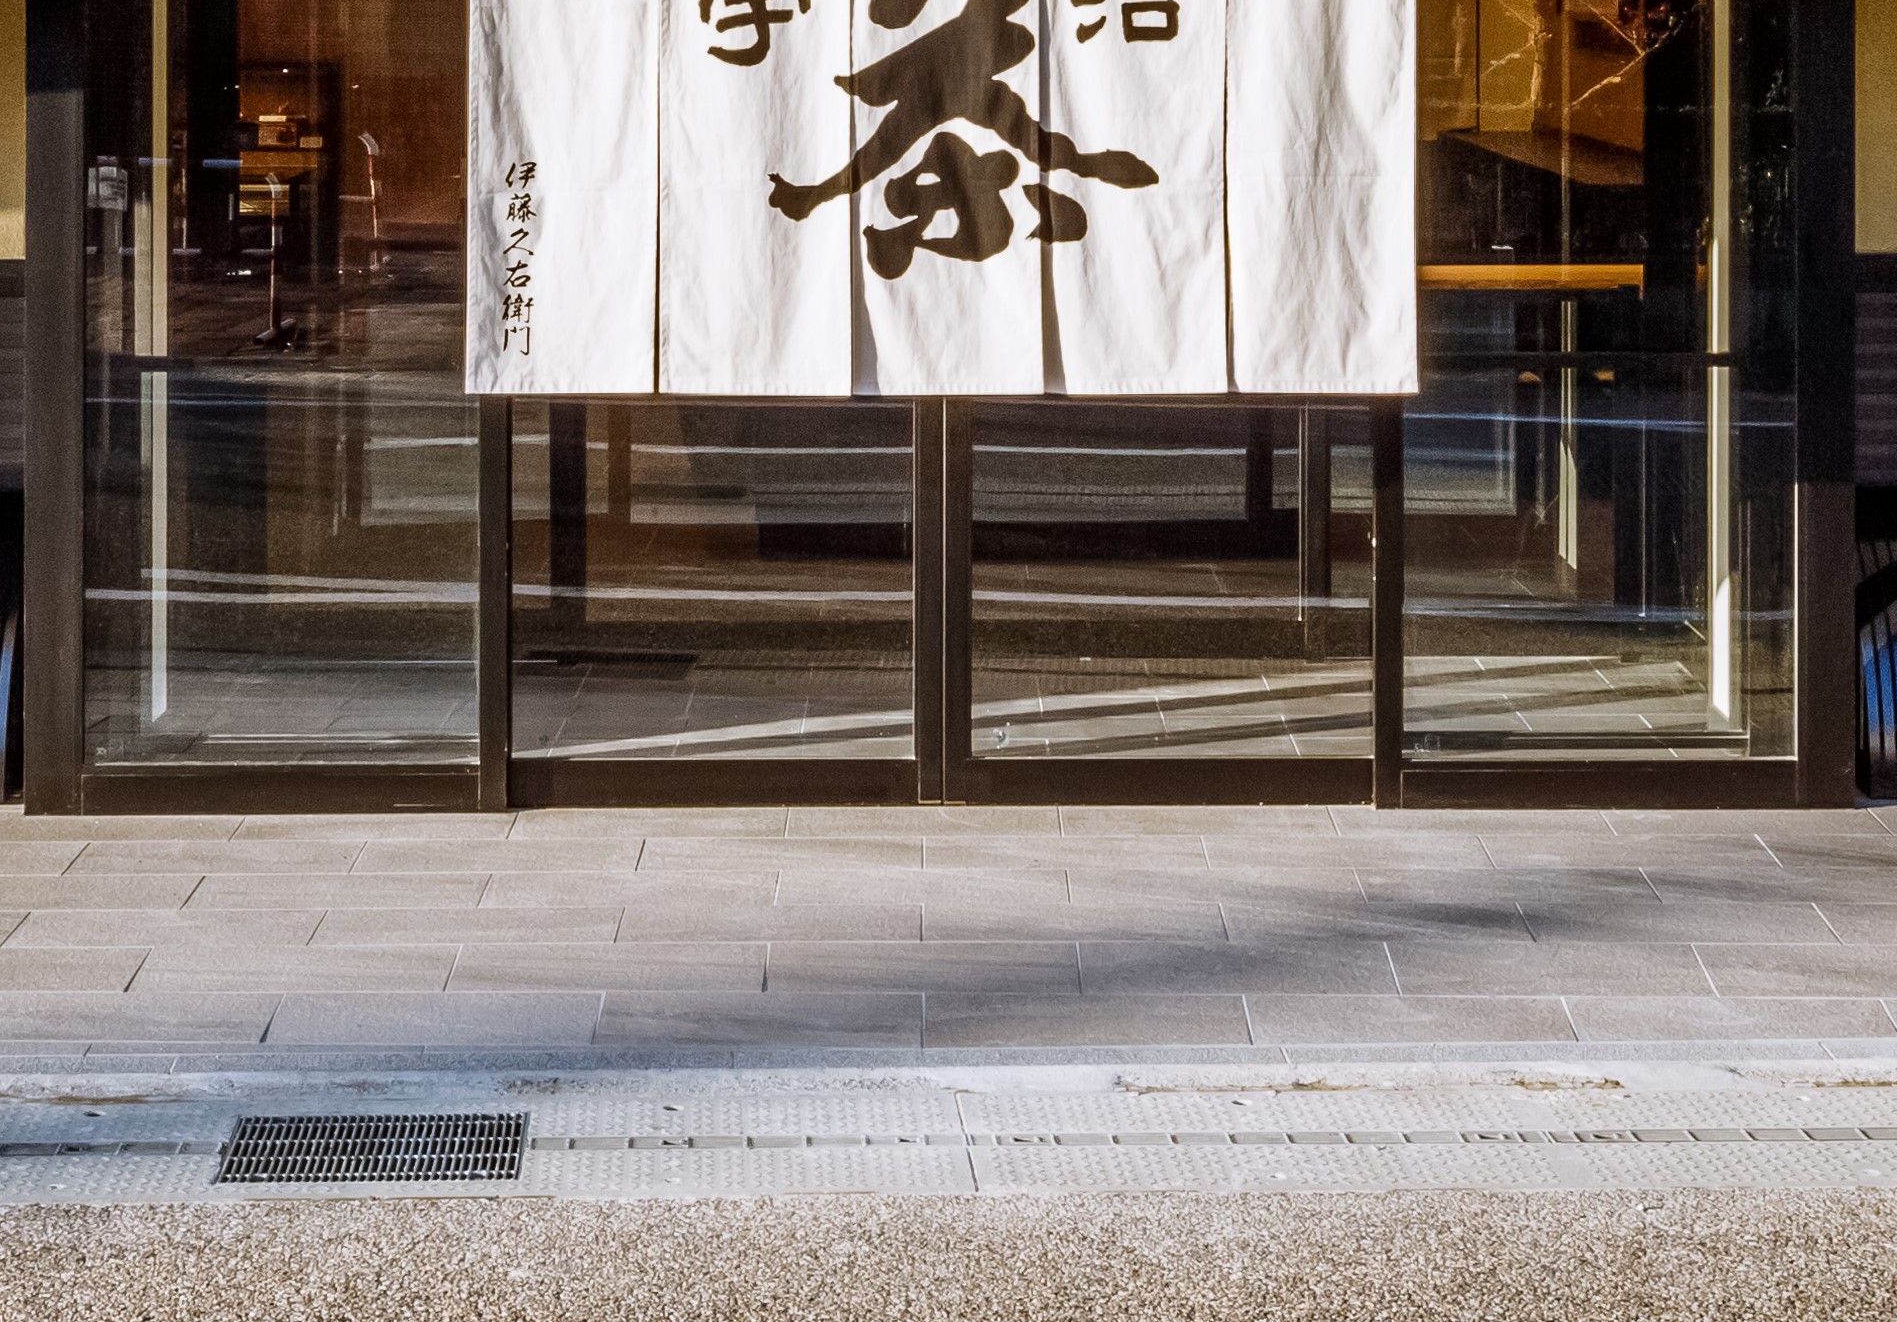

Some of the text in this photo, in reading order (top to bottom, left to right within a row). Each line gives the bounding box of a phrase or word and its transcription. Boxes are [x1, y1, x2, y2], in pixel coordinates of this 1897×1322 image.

[501, 160, 539, 357] 伊藤久右衛門
